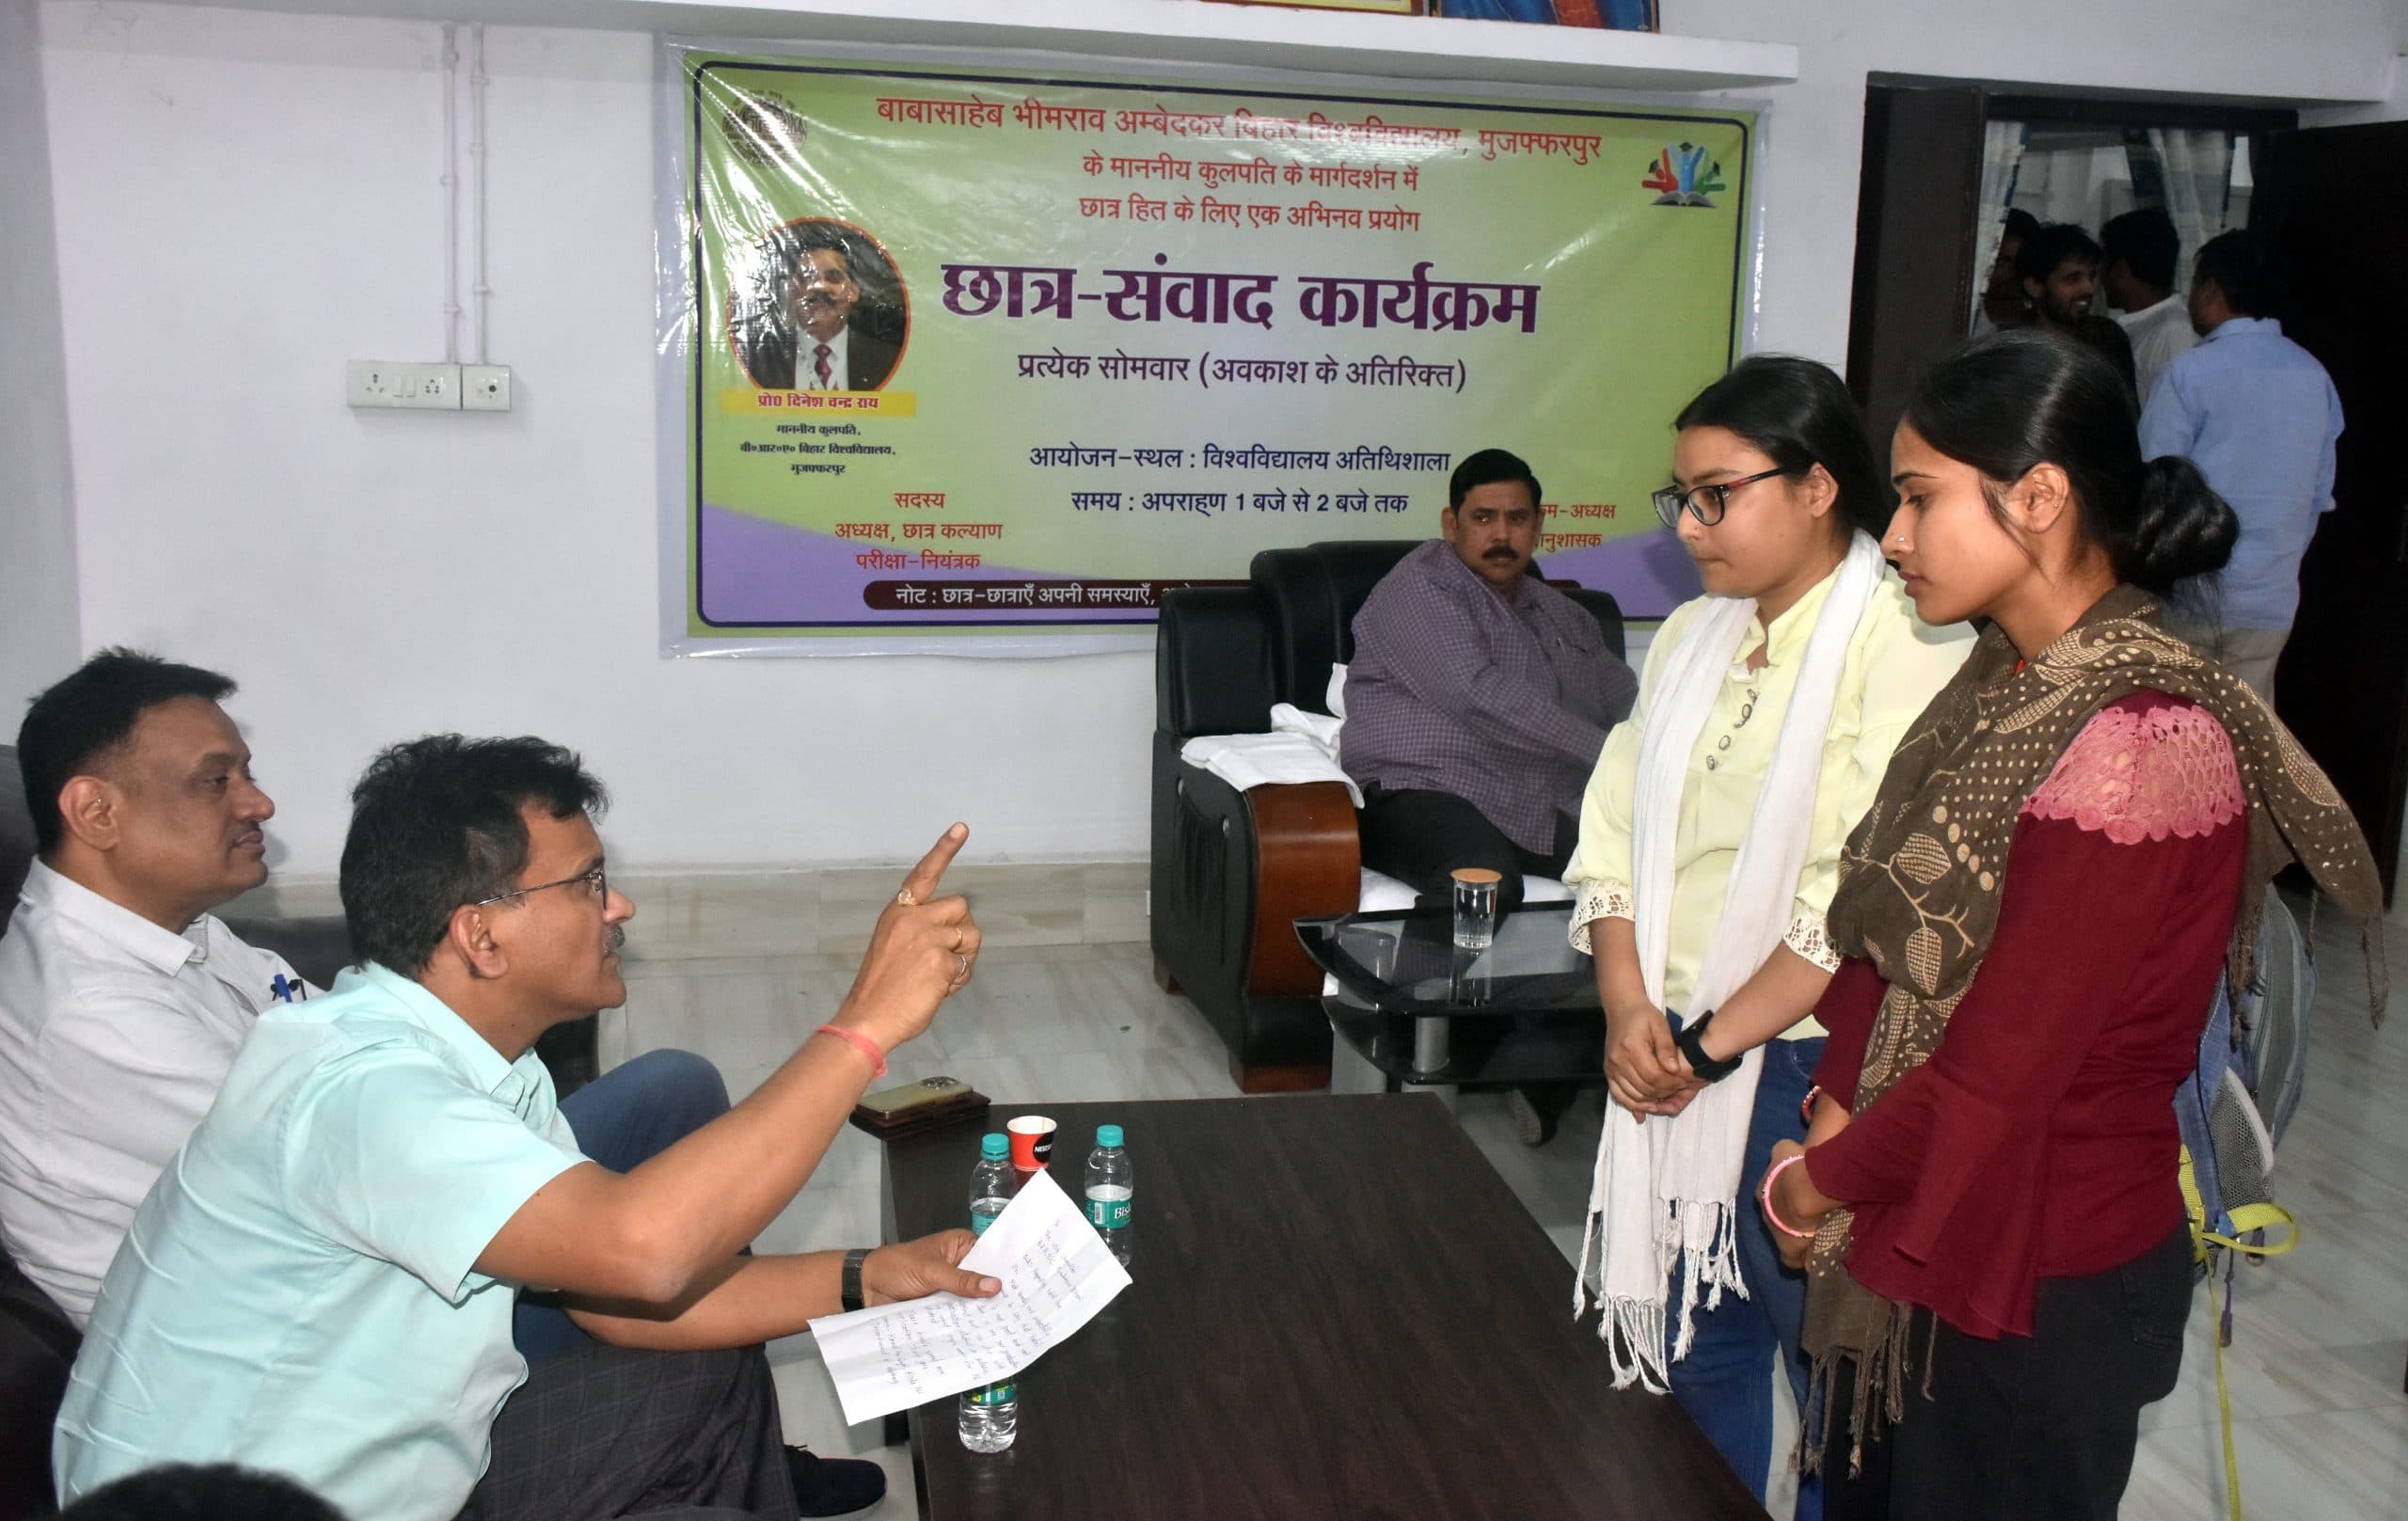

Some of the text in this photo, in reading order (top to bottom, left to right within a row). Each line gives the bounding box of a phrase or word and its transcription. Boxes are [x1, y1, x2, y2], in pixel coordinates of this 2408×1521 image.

[876, 94, 1005, 128] बाबासाहेब
[1012, 98, 1106, 133] भीमराव
[1114, 103, 1227, 137] अम्बेदकर
[1478, 128, 1602, 166] मुजफ्फरपुर
[1083, 149, 1418, 192] के माननीय कुलपति के मार्गदर्शन में
[1079, 192, 1421, 232] छात्र हित के लिए एक अभिनव प्रयोग
[941, 253, 1542, 333] छात्र-संवाद कार्यक्रम
[1018, 347, 1466, 393] प्रत्येक सोमवार (अवकाश के अतिरिक्त)
[787, 393, 823, 408] दिनेश
[857, 397, 879, 408] राय
[776, 423, 816, 435] माननीय
[1030, 442, 1183, 468] आयोजन-स्थल
[1203, 444, 1330, 471] विश्वविद्यालय
[1336, 445, 1450, 472] अतिथिशाला
[895, 493, 945, 509] सदस्य
[1071, 492, 1121, 512] समय
[1235, 495, 1244, 511] 1
[1253, 487, 1288, 514] बजे
[1292, 488, 1310, 513] से
[1317, 494, 1329, 511] 2
[1336, 488, 1370, 515] बजे
[1375, 494, 1409, 514] तक
[835, 523, 1003, 543] अध्यक्ष, छात्र कल्याण
[1534, 533, 1603, 553] ानुशासक
[856, 548, 980, 570] परीक्षा-नियंत्रक
[895, 583, 927, 605] नोट
[942, 582, 1035, 607] छात्र-छात्राएँ
[1038, 582, 1083, 604] अपनी
[1086, 581, 1156, 607] समस्याएँ,
